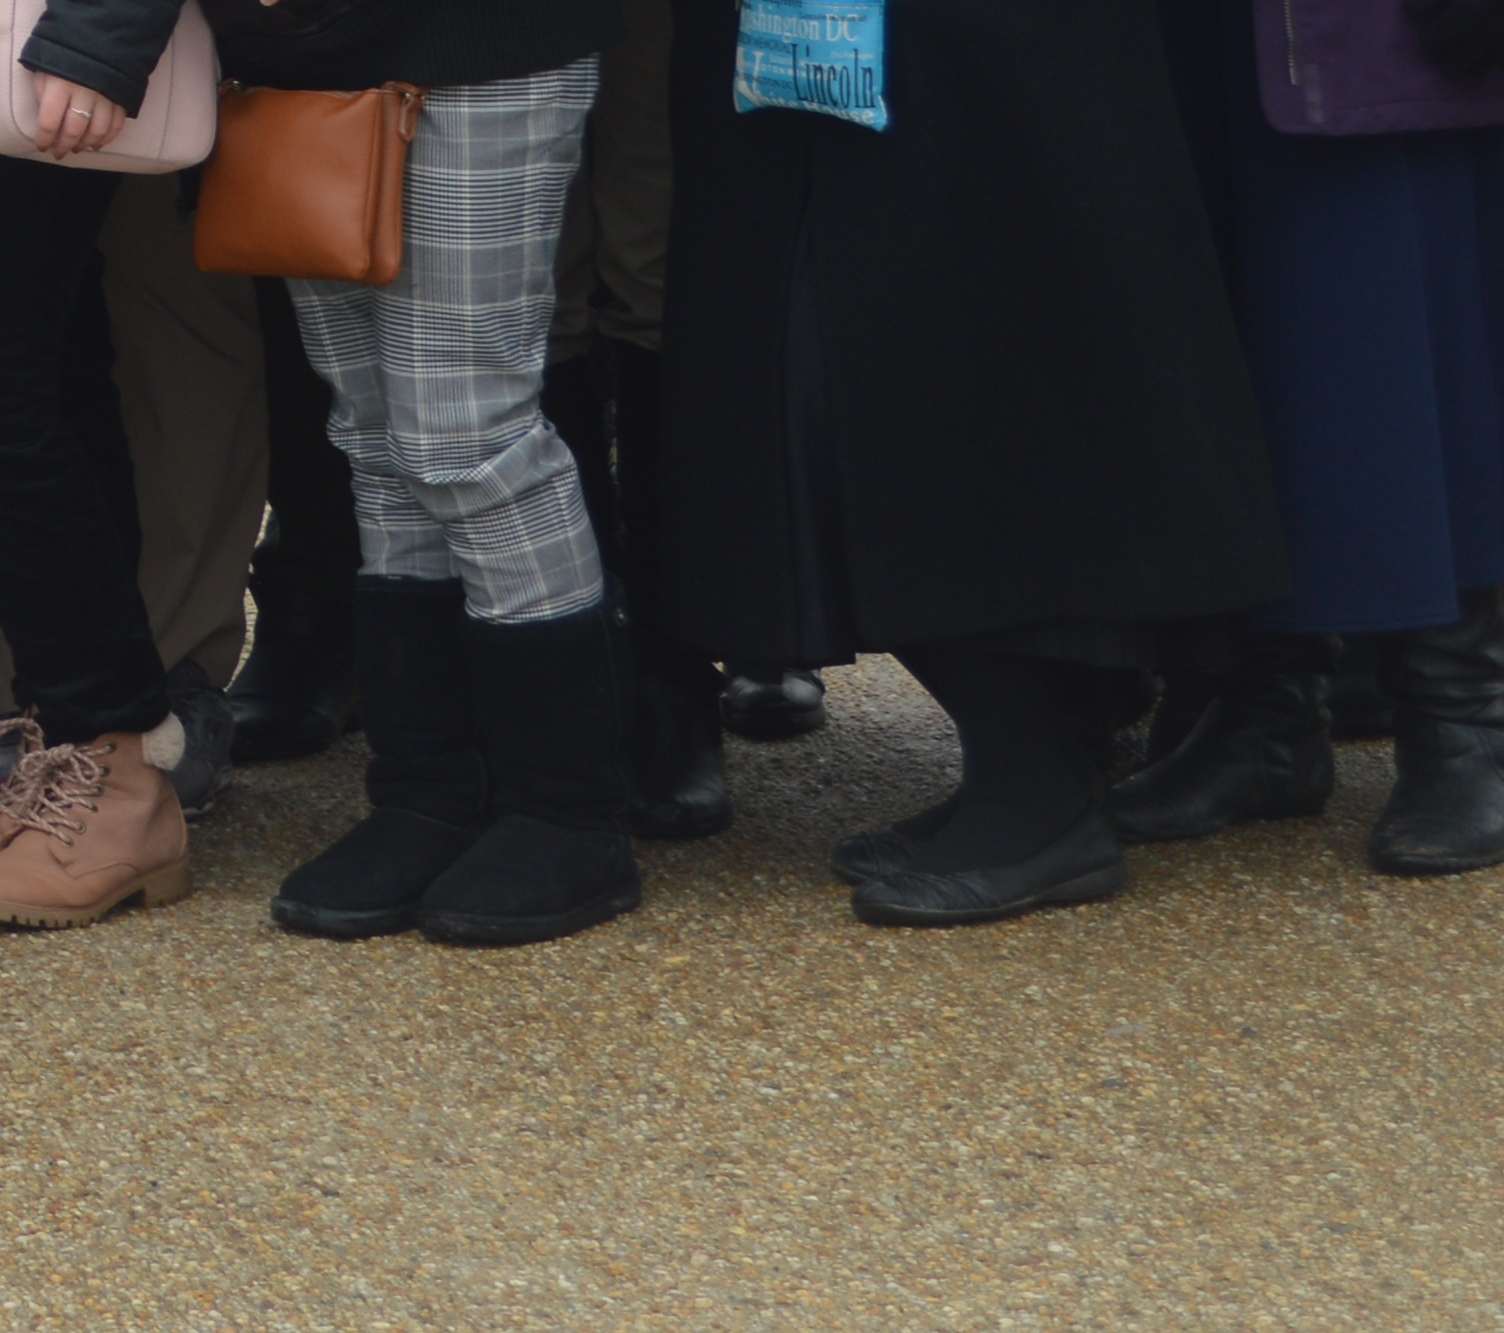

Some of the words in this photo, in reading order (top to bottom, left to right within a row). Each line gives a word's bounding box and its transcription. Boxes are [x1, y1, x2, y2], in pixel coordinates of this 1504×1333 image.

[741, 3, 821, 44] ashington
[826, 13, 859, 43] DC
[791, 43, 876, 109] Lincoln
